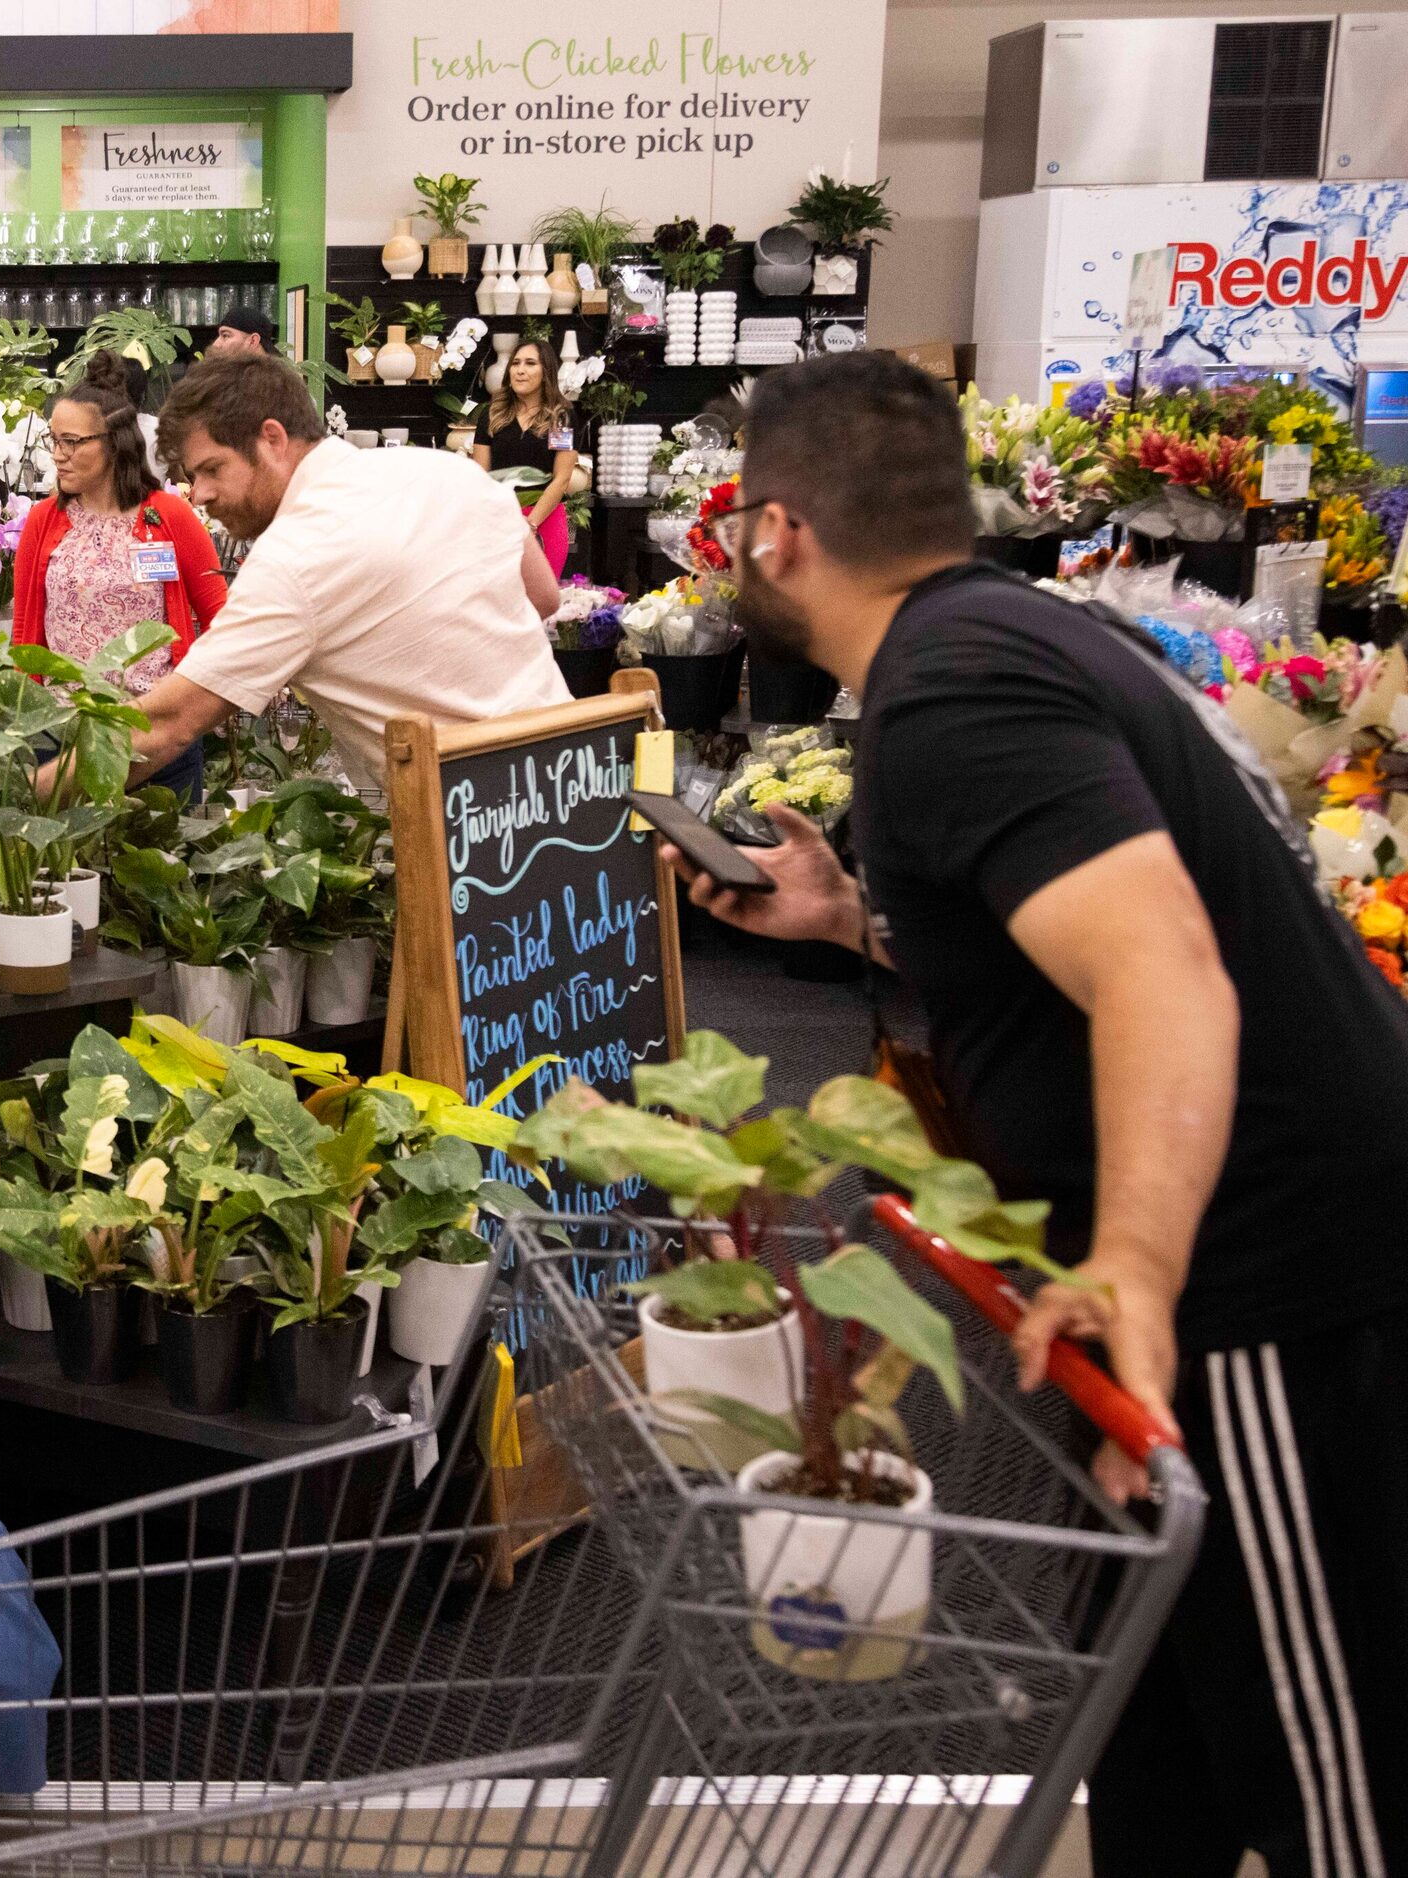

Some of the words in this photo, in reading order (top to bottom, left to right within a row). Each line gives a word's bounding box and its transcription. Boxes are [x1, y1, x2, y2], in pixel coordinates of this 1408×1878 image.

[679, 31, 817, 86] Flowers
[407, 95, 507, 122] Order
[515, 94, 614, 120] online
[624, 93, 671, 119] for
[679, 92, 810, 123] delivery
[103, 131, 222, 172] Freshness
[460, 135, 495, 155] or
[502, 129, 627, 155] in-store
[636, 127, 704, 159] pick
[713, 131, 754, 158] up
[111, 184, 163, 193] Guaranteed
[165, 184, 178, 192] for
[190, 184, 211, 192] least
[136, 172, 193, 180] GUARANTEED
[161, 193, 193, 202] replace
[1167, 239, 1408, 320] Reddy
[447, 755, 550, 874] Fairytale
[456, 900, 556, 1003] Painted
[460, 1012, 529, 1074] Ring
[569, 970, 628, 1032] Fire
